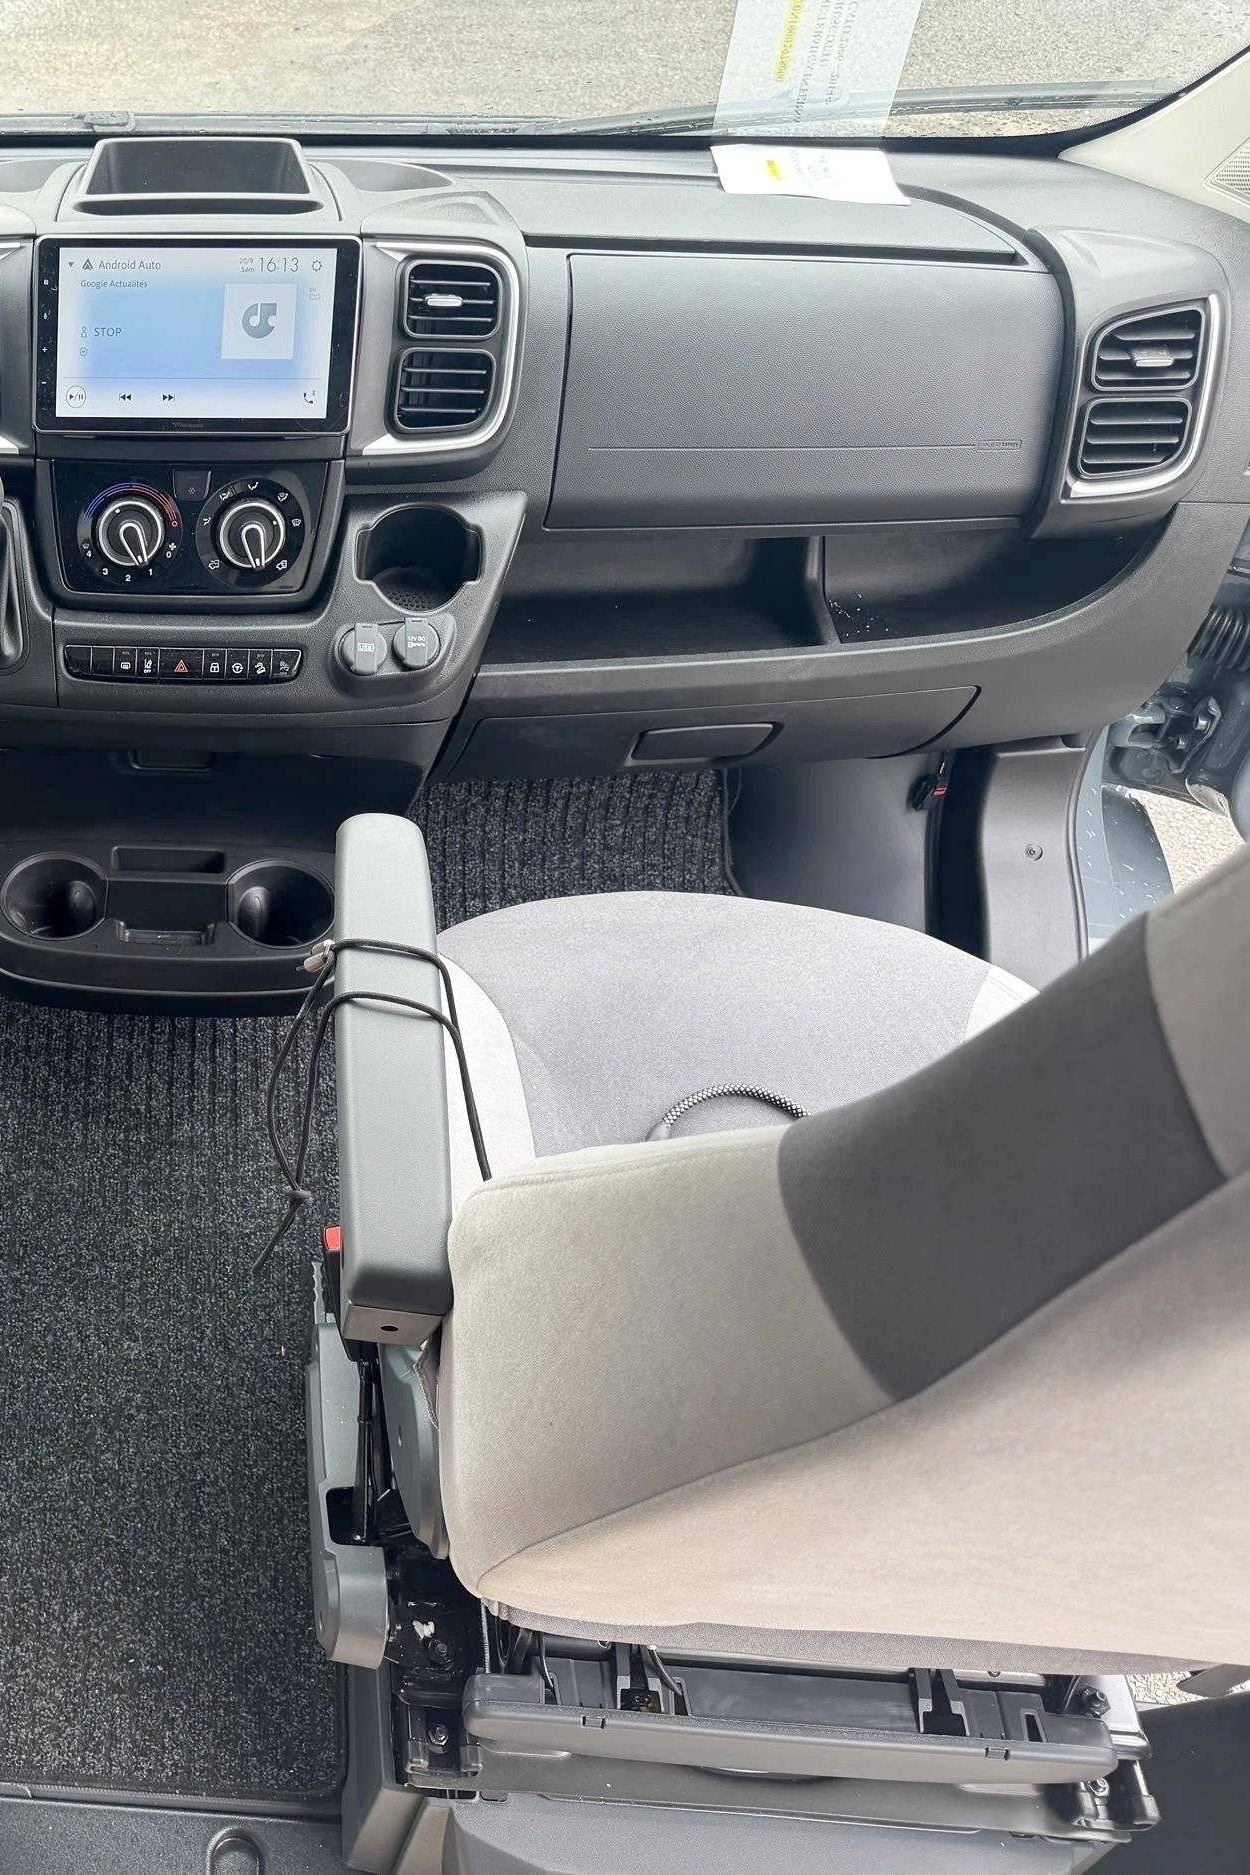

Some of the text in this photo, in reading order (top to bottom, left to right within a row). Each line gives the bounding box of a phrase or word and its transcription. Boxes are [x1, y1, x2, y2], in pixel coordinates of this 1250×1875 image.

[98, 259, 162, 270] Android Auto
[259, 257, 299, 273] 16:13
[80, 280, 108, 290] Google
[94, 327, 122, 337] STOP
